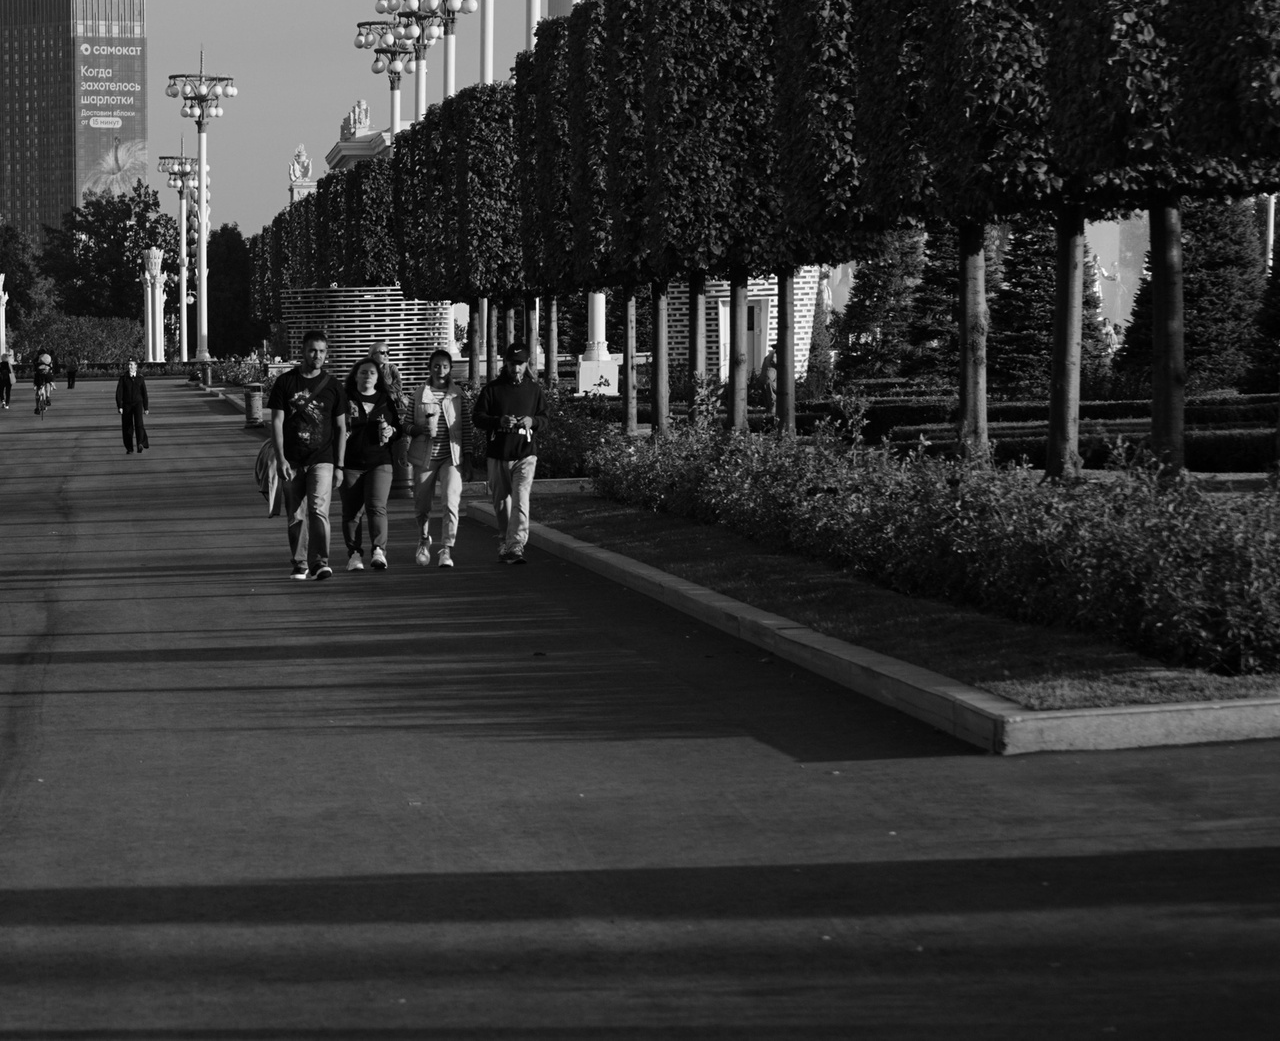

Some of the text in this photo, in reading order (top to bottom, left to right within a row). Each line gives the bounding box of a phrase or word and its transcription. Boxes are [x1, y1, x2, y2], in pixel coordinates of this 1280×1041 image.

[93, 45, 142, 55] самокат
[80, 65, 112, 78] Когда
[80, 82, 141, 91] захотелось
[81, 95, 134, 106] шарлотки
[81, 109, 112, 117] Доставим
